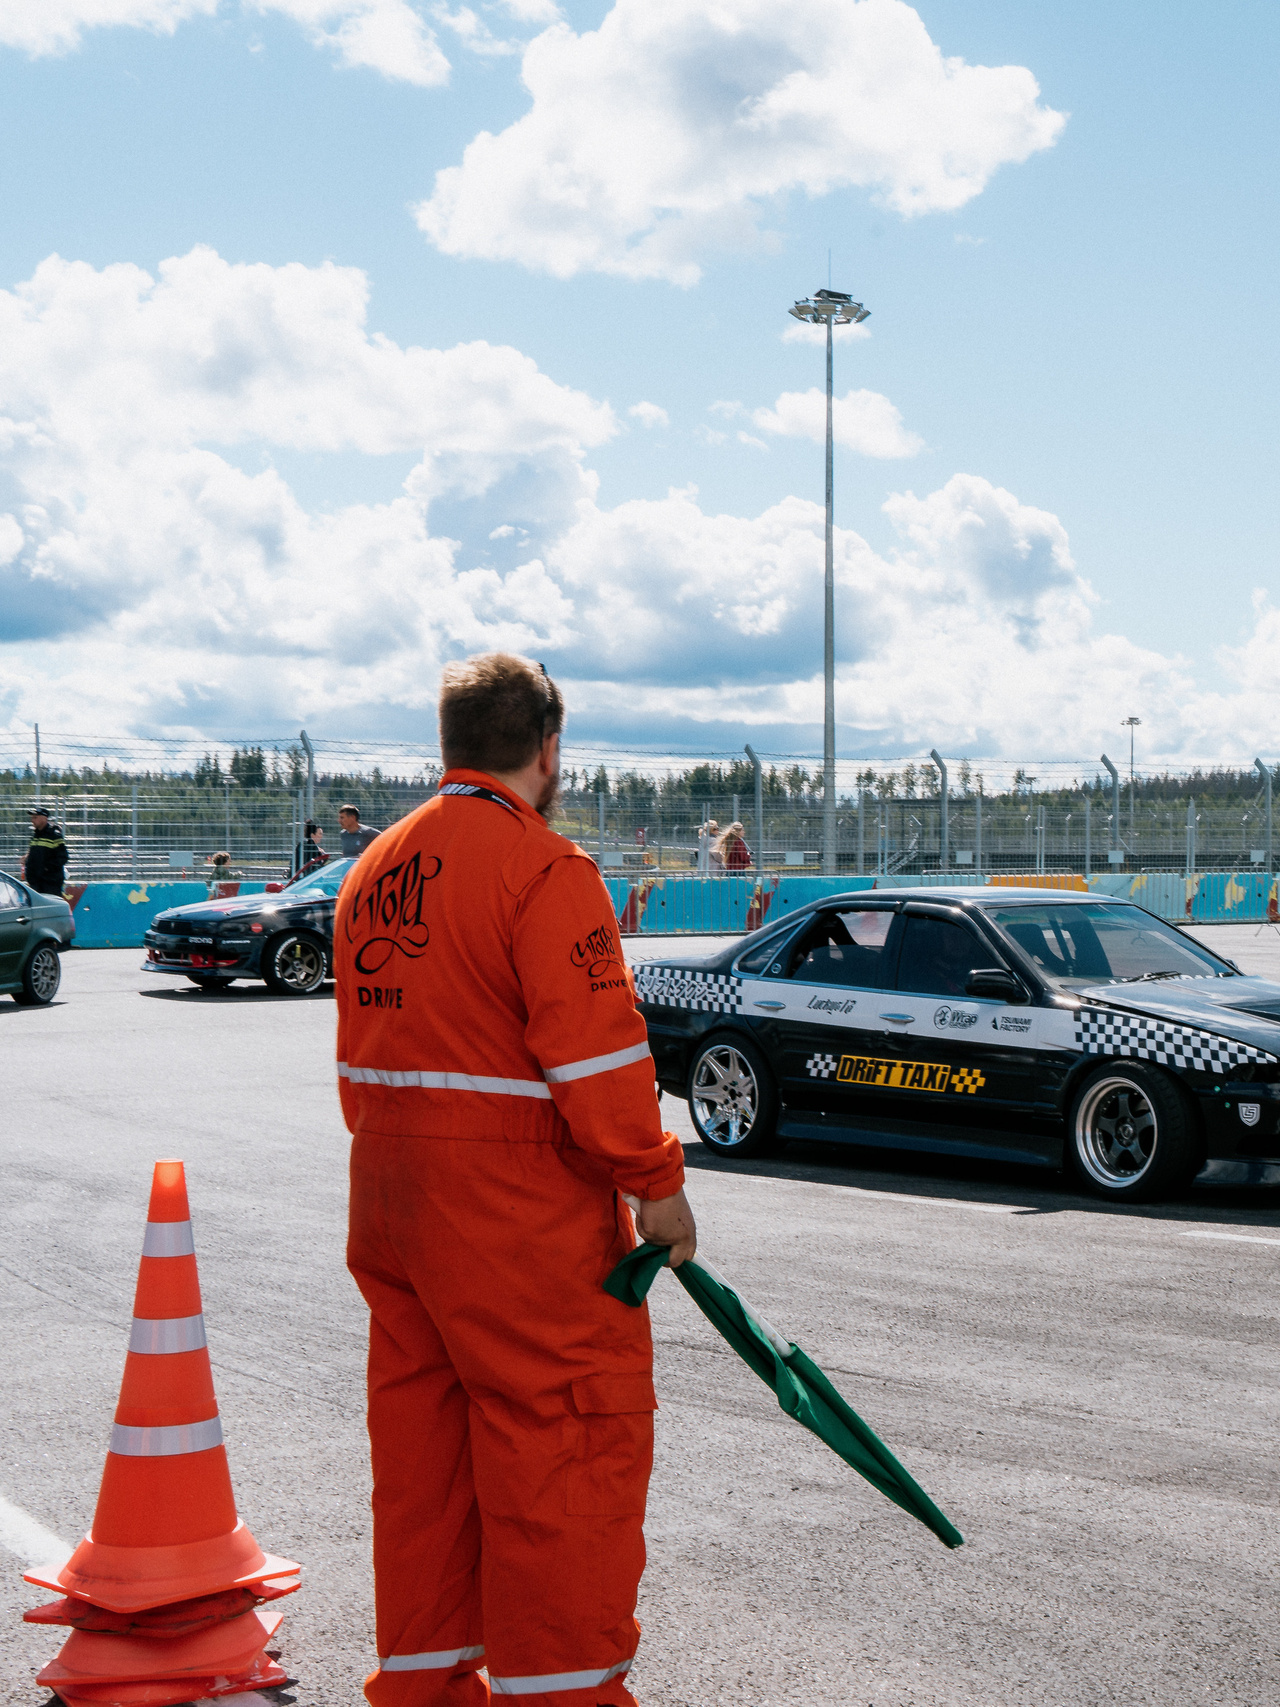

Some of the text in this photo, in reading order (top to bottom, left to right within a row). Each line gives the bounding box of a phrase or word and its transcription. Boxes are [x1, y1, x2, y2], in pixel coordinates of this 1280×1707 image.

[591, 980, 628, 992] DRIVE
[357, 986, 403, 1009] DRIVE
[1001, 1016, 1033, 1025] TSUNAMI
[999, 1023, 1031, 1033] FACTORY
